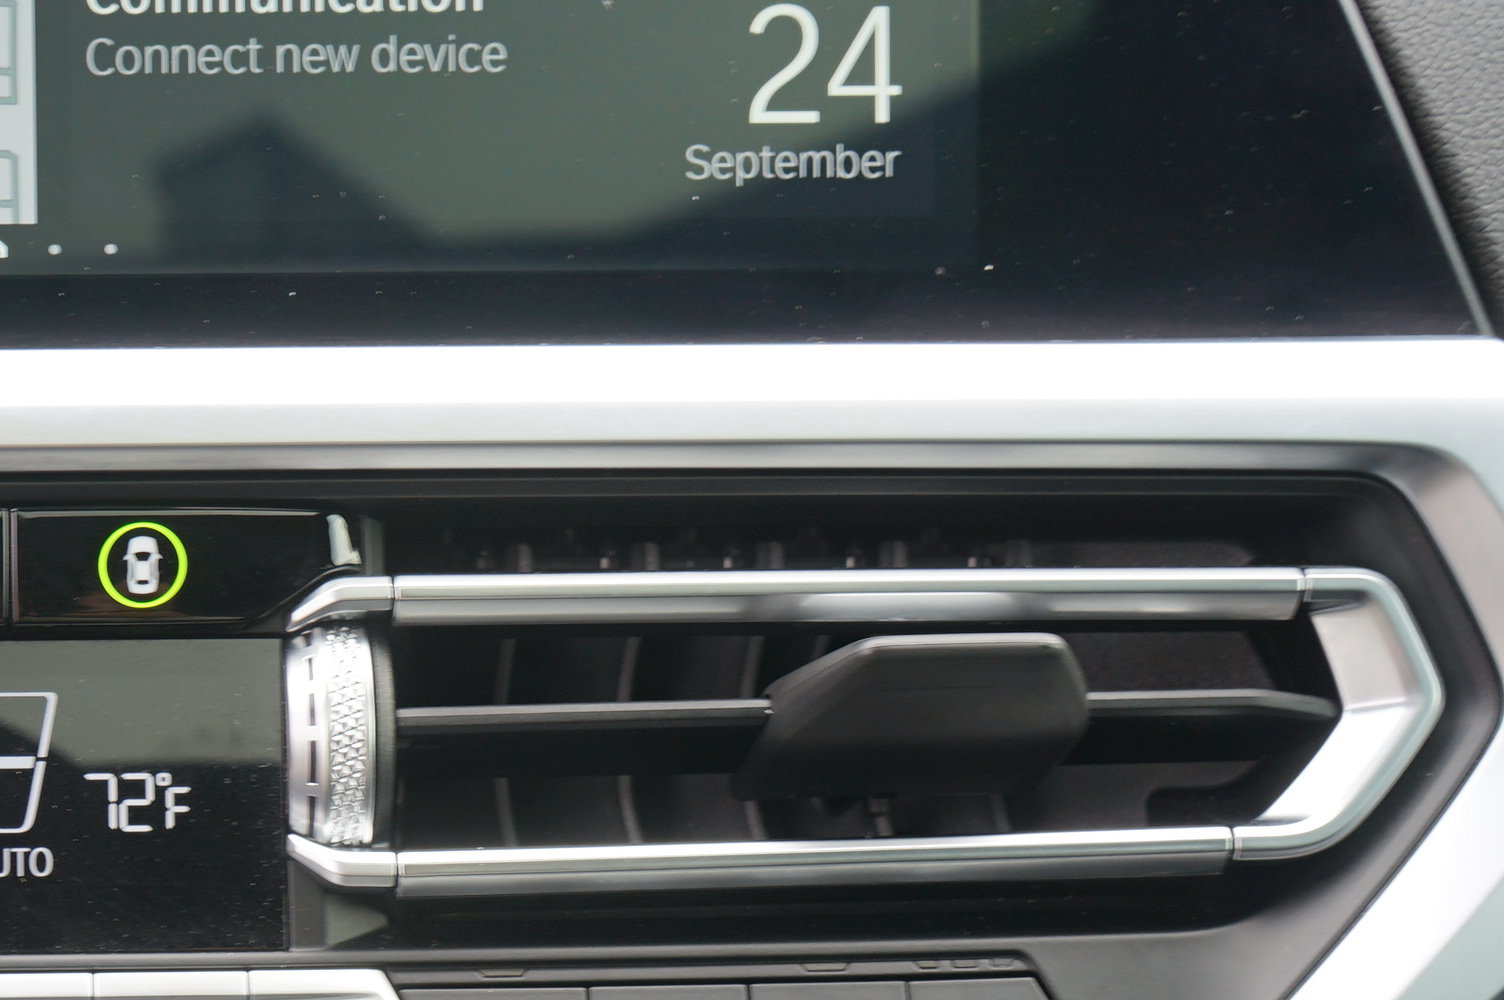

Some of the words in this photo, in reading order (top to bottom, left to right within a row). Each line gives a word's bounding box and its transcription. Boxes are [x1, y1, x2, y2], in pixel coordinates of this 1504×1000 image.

[85, 36, 262, 76] Connect
[274, 38, 360, 75] new
[371, 34, 508, 74] device
[748, 3, 902, 124] 24
[684, 144, 901, 187] September
